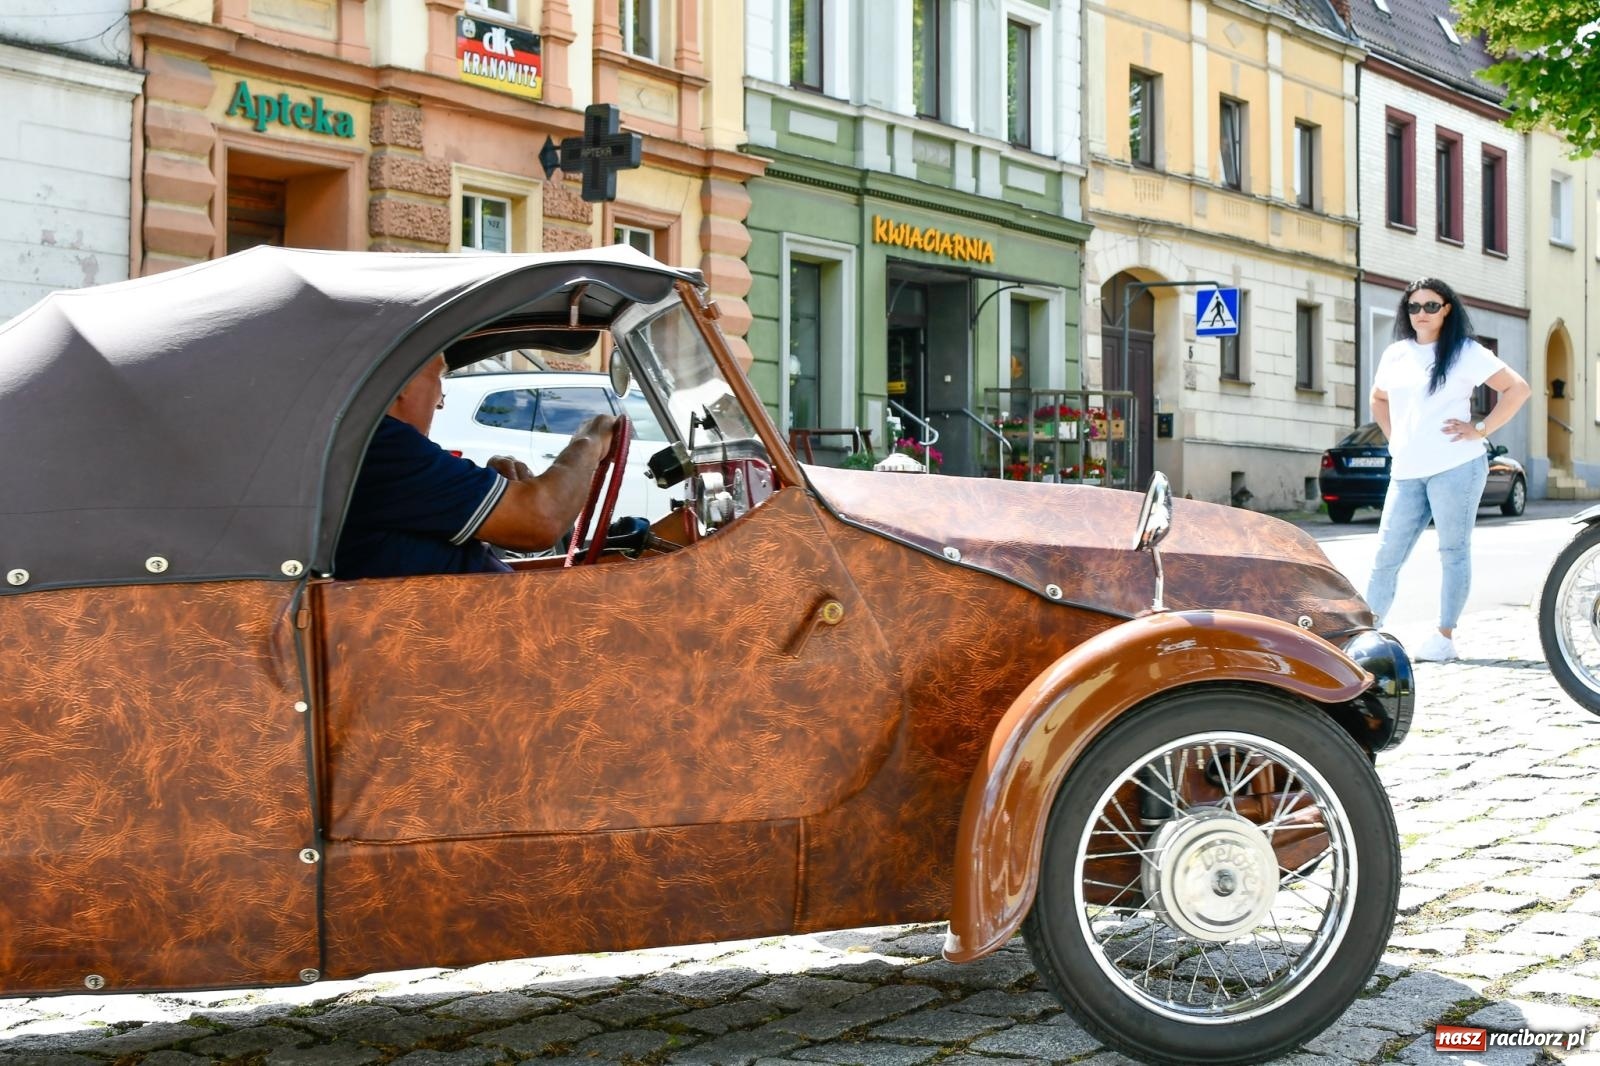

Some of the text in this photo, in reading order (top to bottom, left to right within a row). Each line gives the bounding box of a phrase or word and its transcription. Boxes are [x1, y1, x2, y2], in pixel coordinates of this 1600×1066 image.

[483, 27, 515, 57] dk
[463, 51, 537, 88] KRANOWITZ
[226, 80, 355, 139] Apteka
[872, 214, 995, 263] KWIACIARNIA
